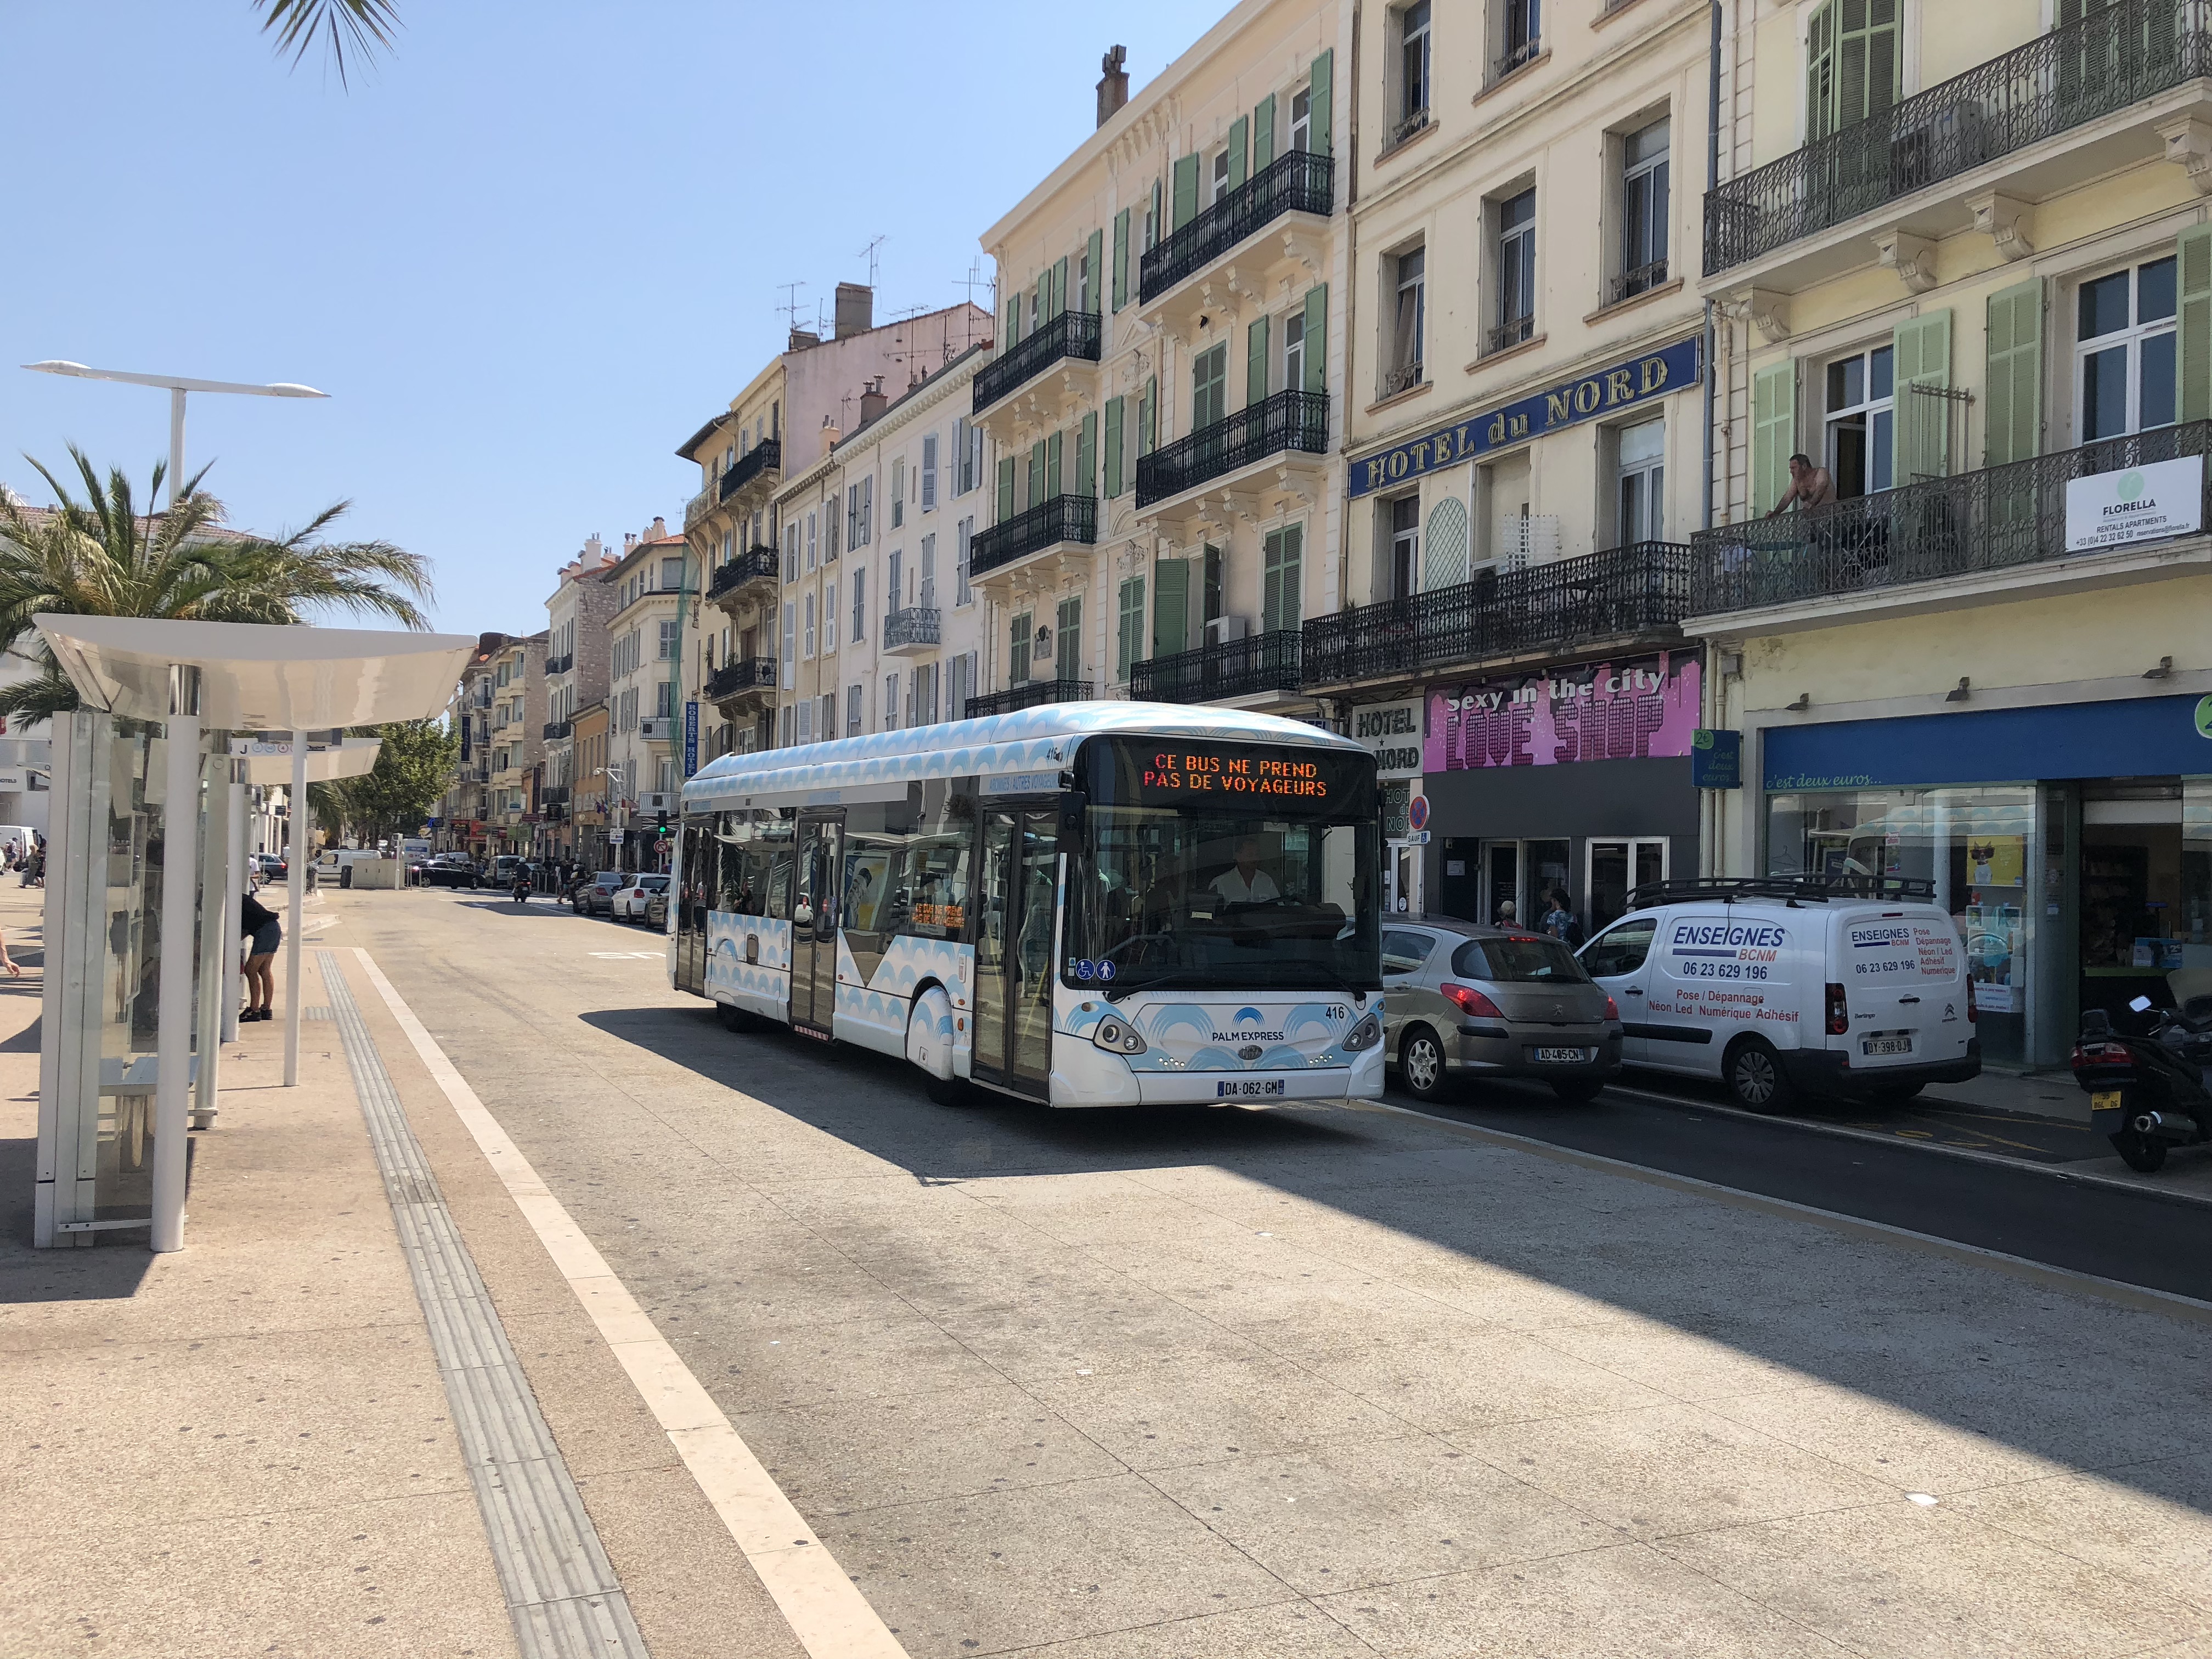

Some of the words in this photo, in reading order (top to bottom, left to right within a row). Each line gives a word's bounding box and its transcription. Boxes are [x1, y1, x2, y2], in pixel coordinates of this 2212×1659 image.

[1366, 426, 1475, 488] HOTEL
[1488, 413, 1528, 444] du
[1545, 357, 1668, 426] NORD
[2103, 499, 2157, 516] FLORELLA
[2097, 523, 2124, 533] RENTALS
[2125, 516, 2167, 529] APARTMENTS
[2076, 537, 2086, 546] +33
[2087, 535, 2098, 546] (0)4
[2100, 534, 2107, 543] 22
[2108, 532, 2116, 541] 32
[2117, 531, 2124, 540] 62
[2126, 530, 2133, 538] 50
[1447, 690, 1503, 713] Sexy
[1513, 684, 1537, 704] in
[1549, 679, 1594, 699] the
[1605, 668, 1666, 693] city
[1356, 708, 1417, 738] HOTEL
[1446, 707, 1534, 771] LOVE
[1554, 694, 1664, 763] SHOP
[1696, 732, 1710, 744] 2€
[687, 747, 695, 775] HOTEL
[1047, 747, 1058, 760] 416
[1373, 747, 1419, 770] NORD
[1155, 753, 1177, 769] CE
[1186, 755, 1220, 772] BUS
[1229, 758, 1251, 774] NE
[1260, 760, 1317, 778] PREND
[1144, 770, 1181, 788] PAS
[1189, 774, 1212, 790] DE
[1221, 776, 1327, 796] VOYAGEURS
[1767, 774, 1795, 788] c'est
[1796, 773, 1832, 787] deux
[1673, 926, 1785, 947] ENSEIGNES
[1852, 928, 1910, 941] ENSEIGNES
[1912, 927, 1930, 936] Pose
[1915, 937, 1951, 946] Dépannage
[1738, 949, 1777, 962] BCNM
[1918, 947, 1936, 956] Néon
[1941, 947, 1953, 956] Led
[1683, 961, 1697, 975] 06
[1700, 963, 1715, 977] 23
[1718, 964, 1741, 978] 629
[1745, 966, 1768, 980] 196
[1855, 963, 1867, 974] 06
[1869, 962, 1880, 973] 23
[1882, 961, 1898, 972] 629
[1900, 960, 1915, 970] 196
[1677, 989, 1700, 1001] Pose
[1708, 990, 1764, 1006] Dépannage
[1325, 1006, 1344, 1019] 416
[1649, 1000, 1672, 1013] Néon
[1675, 1003, 1692, 1014] Led
[1699, 1005, 1751, 1021] Numérique
[1756, 1008, 1799, 1023] Adhésif
[1212, 1032, 1240, 1041] PALM
[1242, 1031, 1284, 1041] EXPRESS
[1541, 1048, 1579, 1060] AD-405-CN
[1868, 1041, 1906, 1053] DY-398-DJ
[1225, 1081, 1278, 1095] DA-062-GM
